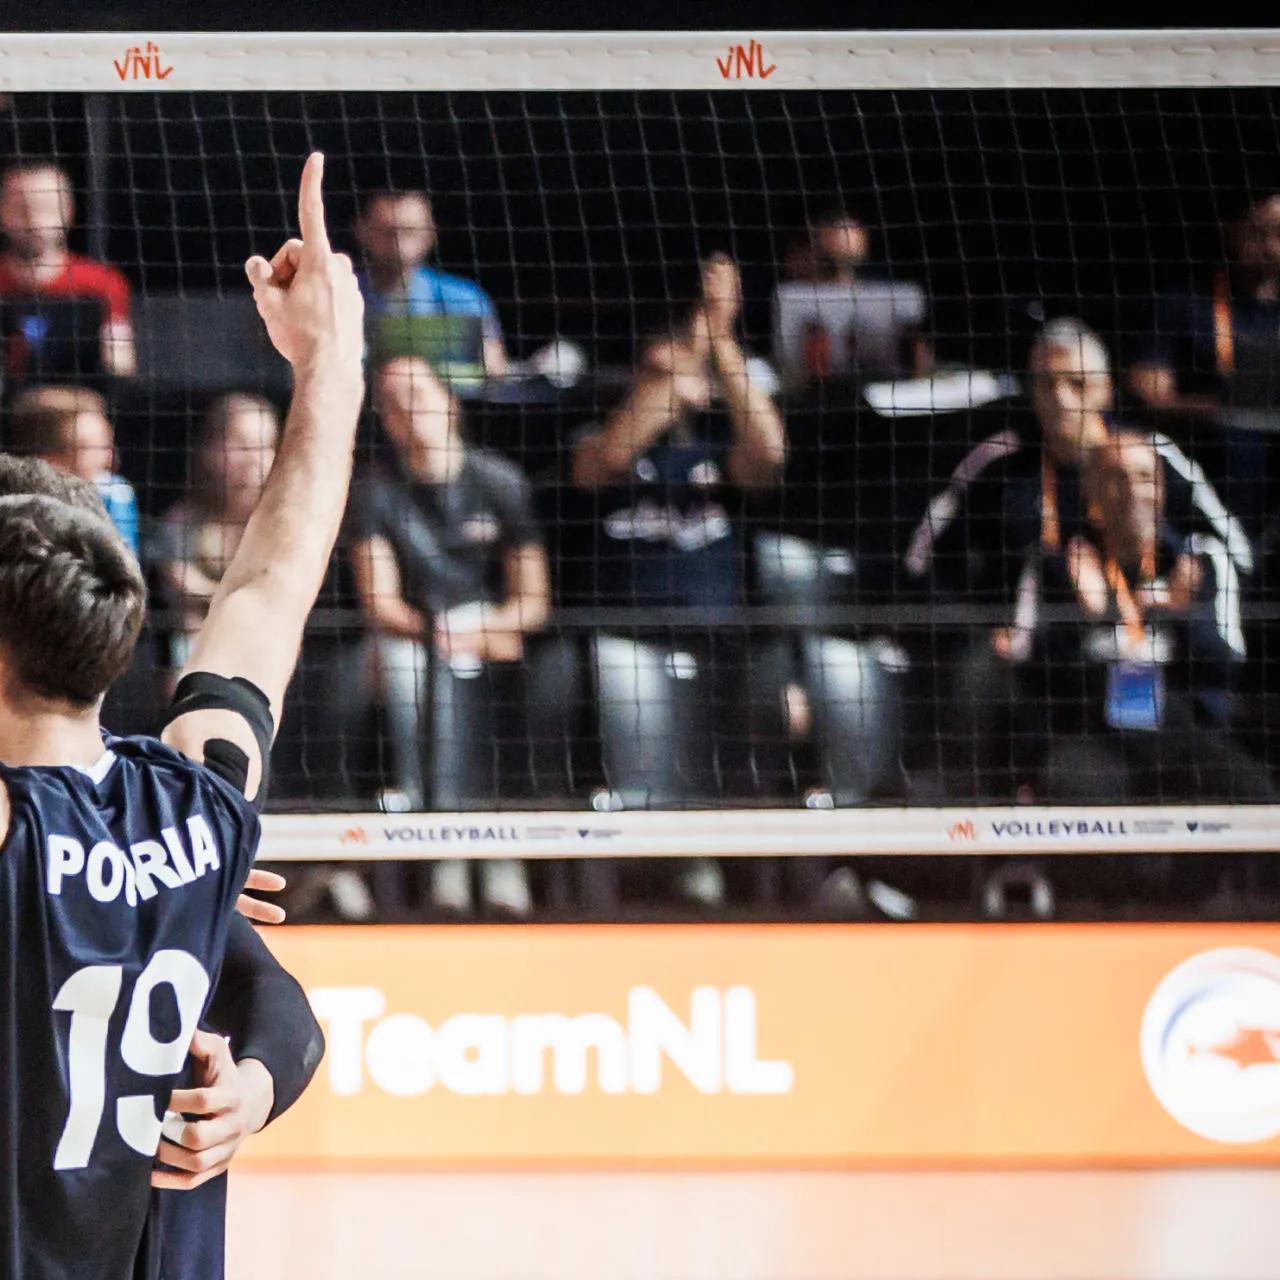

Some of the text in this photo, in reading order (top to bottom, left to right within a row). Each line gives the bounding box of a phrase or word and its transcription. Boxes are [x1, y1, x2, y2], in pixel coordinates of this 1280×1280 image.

[383, 826, 519, 841] VOLLEYBALL
[991, 819, 1129, 837] VOLLEYBALL
[51, 949, 211, 1171] 19
[308, 985, 793, 1096] TeamNL
